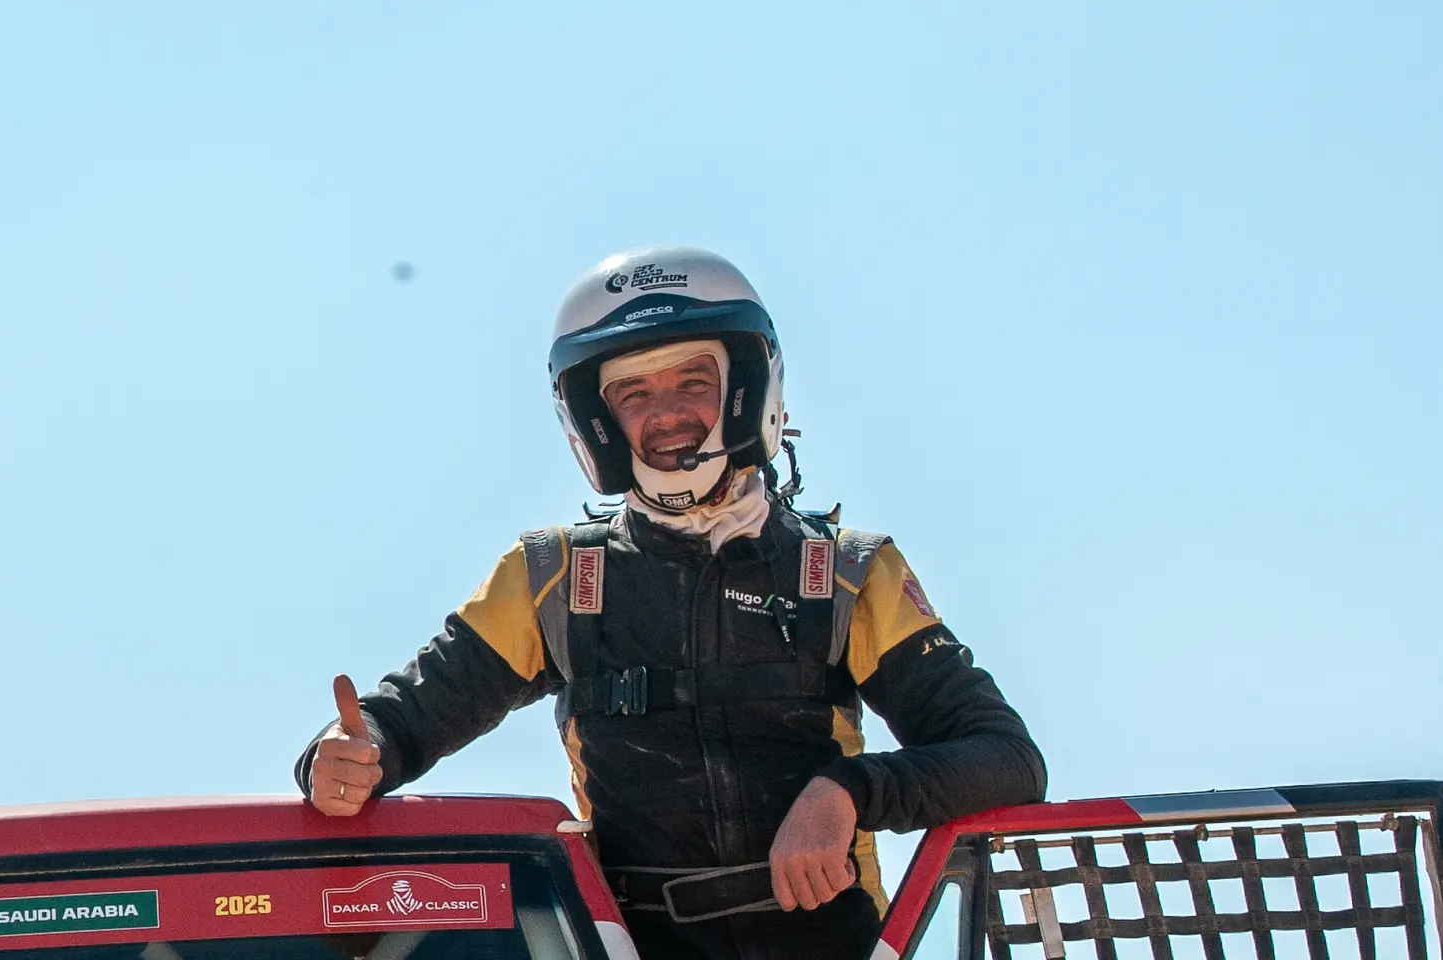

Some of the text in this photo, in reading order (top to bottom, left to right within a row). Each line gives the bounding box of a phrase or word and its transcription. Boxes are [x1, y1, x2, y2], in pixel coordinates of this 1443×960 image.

[630, 274, 688, 287] CENTRUM
[625, 305, 674, 322] sparco
[662, 496, 691, 507] OMP
[808, 545, 826, 593] SIMPSON
[577, 555, 594, 607] SIMPSON
[725, 588, 762, 605] Hugo
[62, 904, 139, 920] ARABIA
[215, 895, 272, 916] 2025
[332, 900, 480, 914] DAKAR CLASSIC
